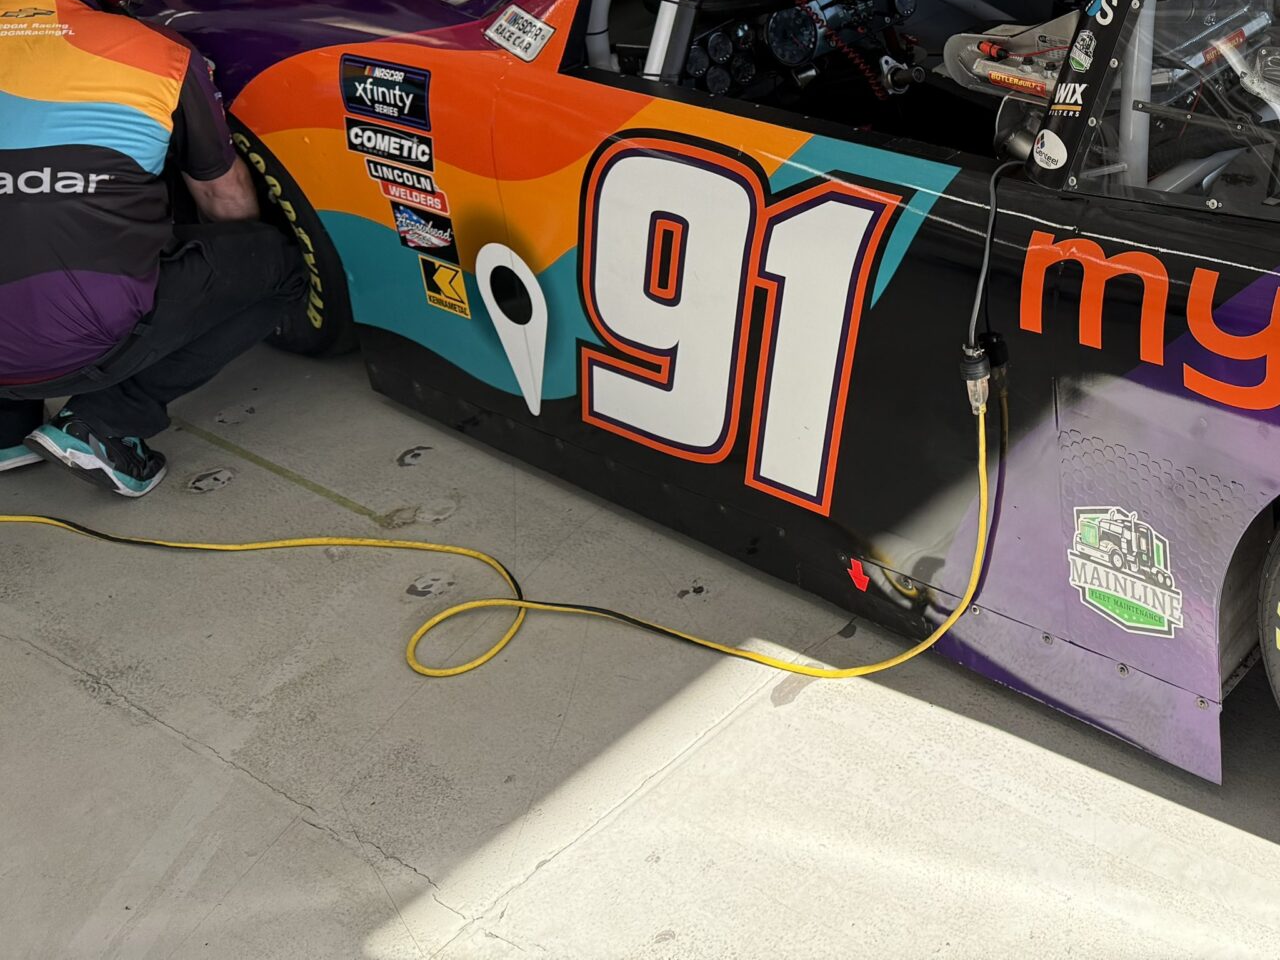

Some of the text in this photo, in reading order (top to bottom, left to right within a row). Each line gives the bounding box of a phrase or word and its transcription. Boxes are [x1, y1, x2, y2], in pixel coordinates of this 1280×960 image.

[494, 23, 532, 53] RACE CAR
[510, 12, 543, 42] NASCAR
[372, 66, 405, 83] NASCAR
[354, 78, 414, 115] xfinity
[1053, 82, 1088, 105] WIX
[374, 102, 399, 117] SERIES
[1048, 109, 1080, 117] FILTERS
[350, 126, 431, 163] COMETIC
[368, 161, 433, 192] LINCOLN
[387, 184, 443, 210] WELDERS
[427, 293, 470, 317] KENNAMETAL
[582, 146, 898, 514] 91
[1070, 558, 1181, 621] MAINLINE
[1090, 589, 1164, 625] FLEET MAINTENANCE
